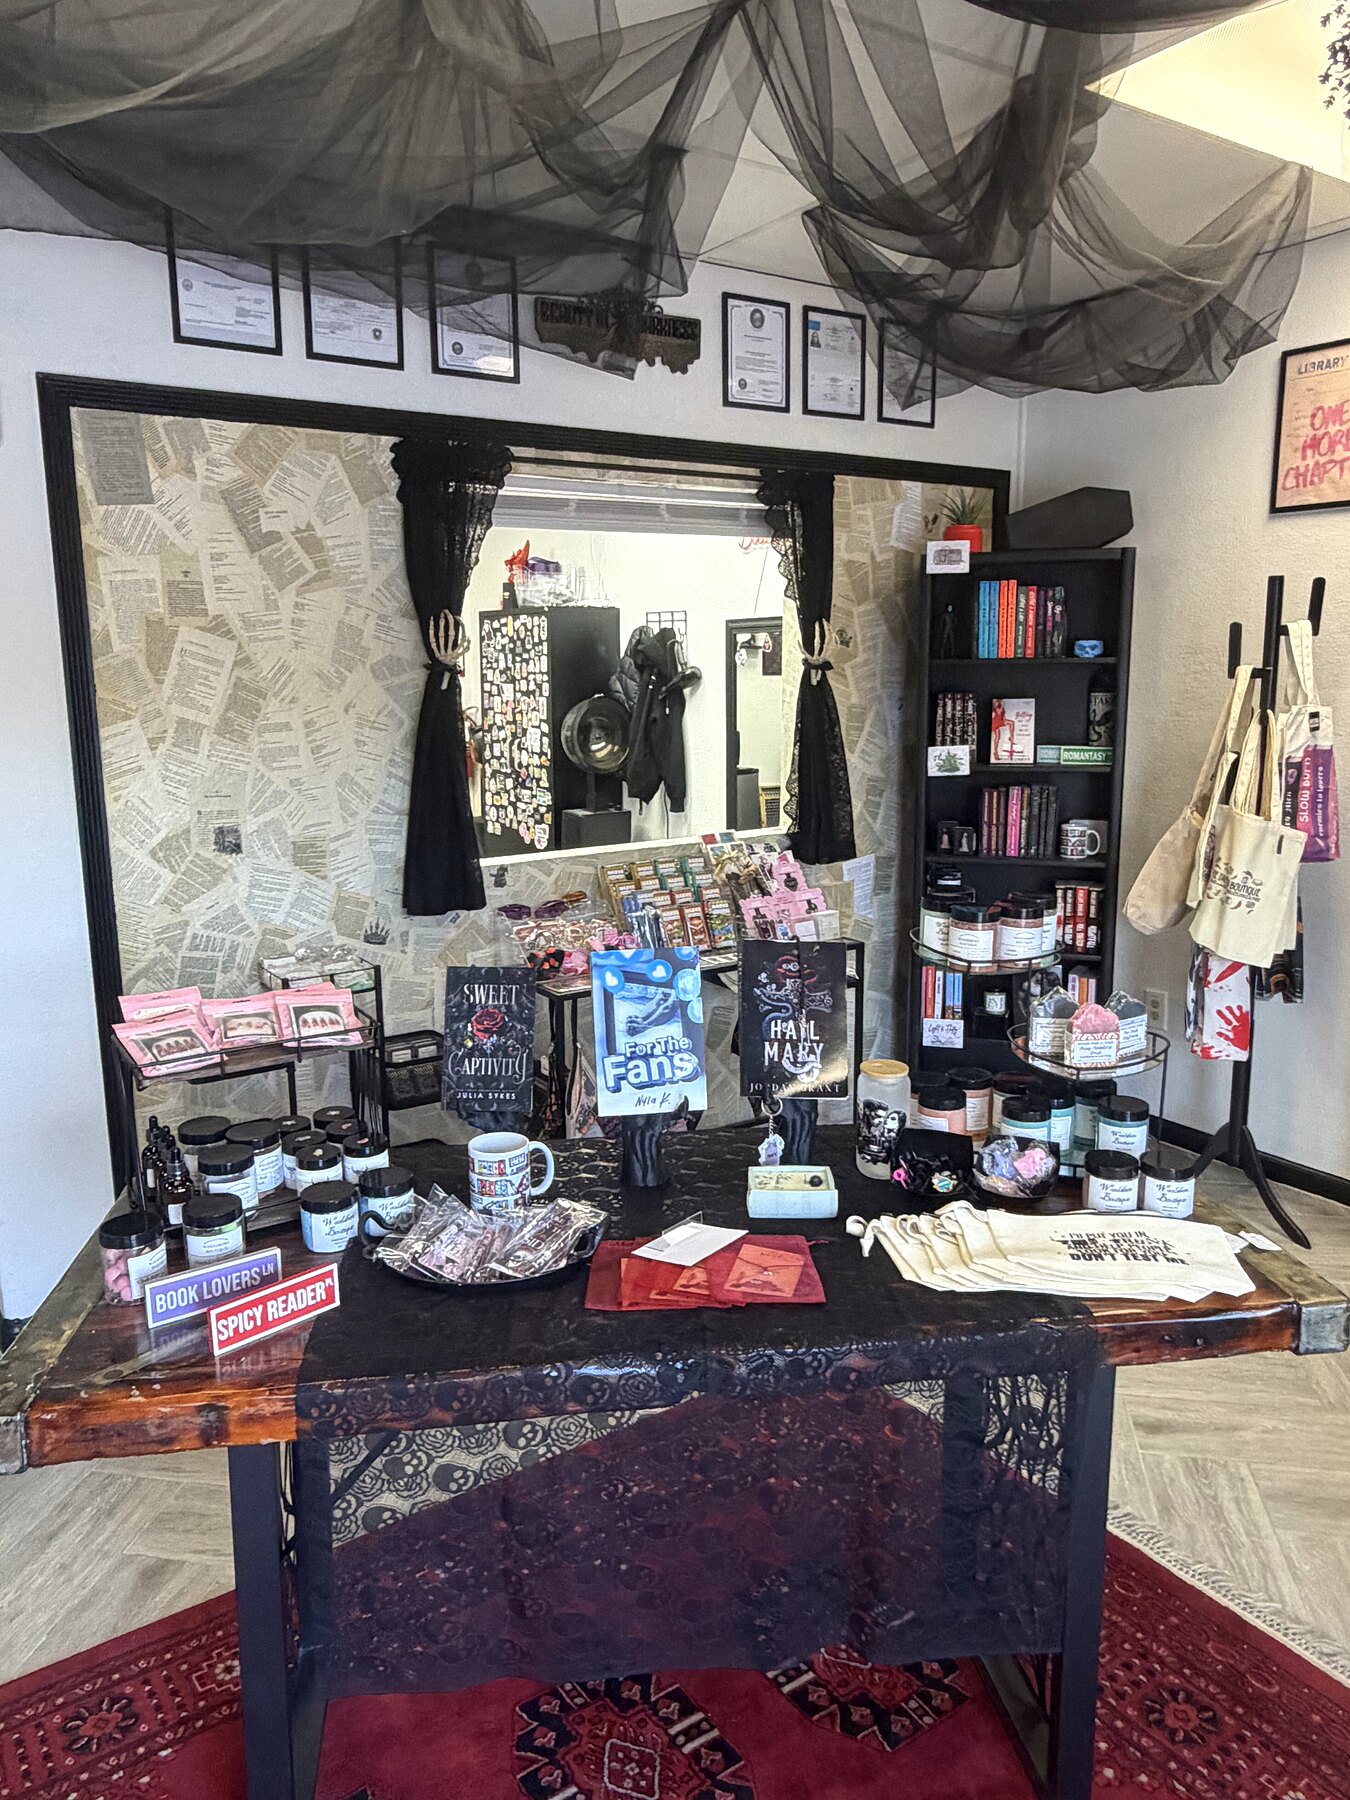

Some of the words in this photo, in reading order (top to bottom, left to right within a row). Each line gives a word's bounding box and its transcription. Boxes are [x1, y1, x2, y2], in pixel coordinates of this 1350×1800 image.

[1298, 356, 1350, 375] LIBRARY
[1310, 400, 1350, 431] ONE
[1282, 456, 1350, 491] CHAPT
[1063, 750, 1107, 761] ROMANTASY
[1299, 789, 1311, 823] SLOW
[463, 982, 519, 1005] SWEET
[770, 1020, 820, 1041] HAIL
[625, 1041, 660, 1058] For
[656, 1035, 693, 1054] The
[764, 1041, 824, 1066] MARY
[448, 1046, 529, 1084] CAPTIVITY
[603, 1052, 699, 1092] Fans
[456, 1091, 485, 1100] JULIA
[488, 1092, 516, 1101] SYKES
[1068, 1253, 1117, 1261] DON'T
[1120, 1253, 1160, 1262] TEST
[155, 1284, 200, 1314] BOOK
[202, 1267, 262, 1301] LOVERS
[261, 1262, 275, 1278] LN
[217, 1306, 264, 1342] SPICY
[266, 1283, 326, 1322] READER
